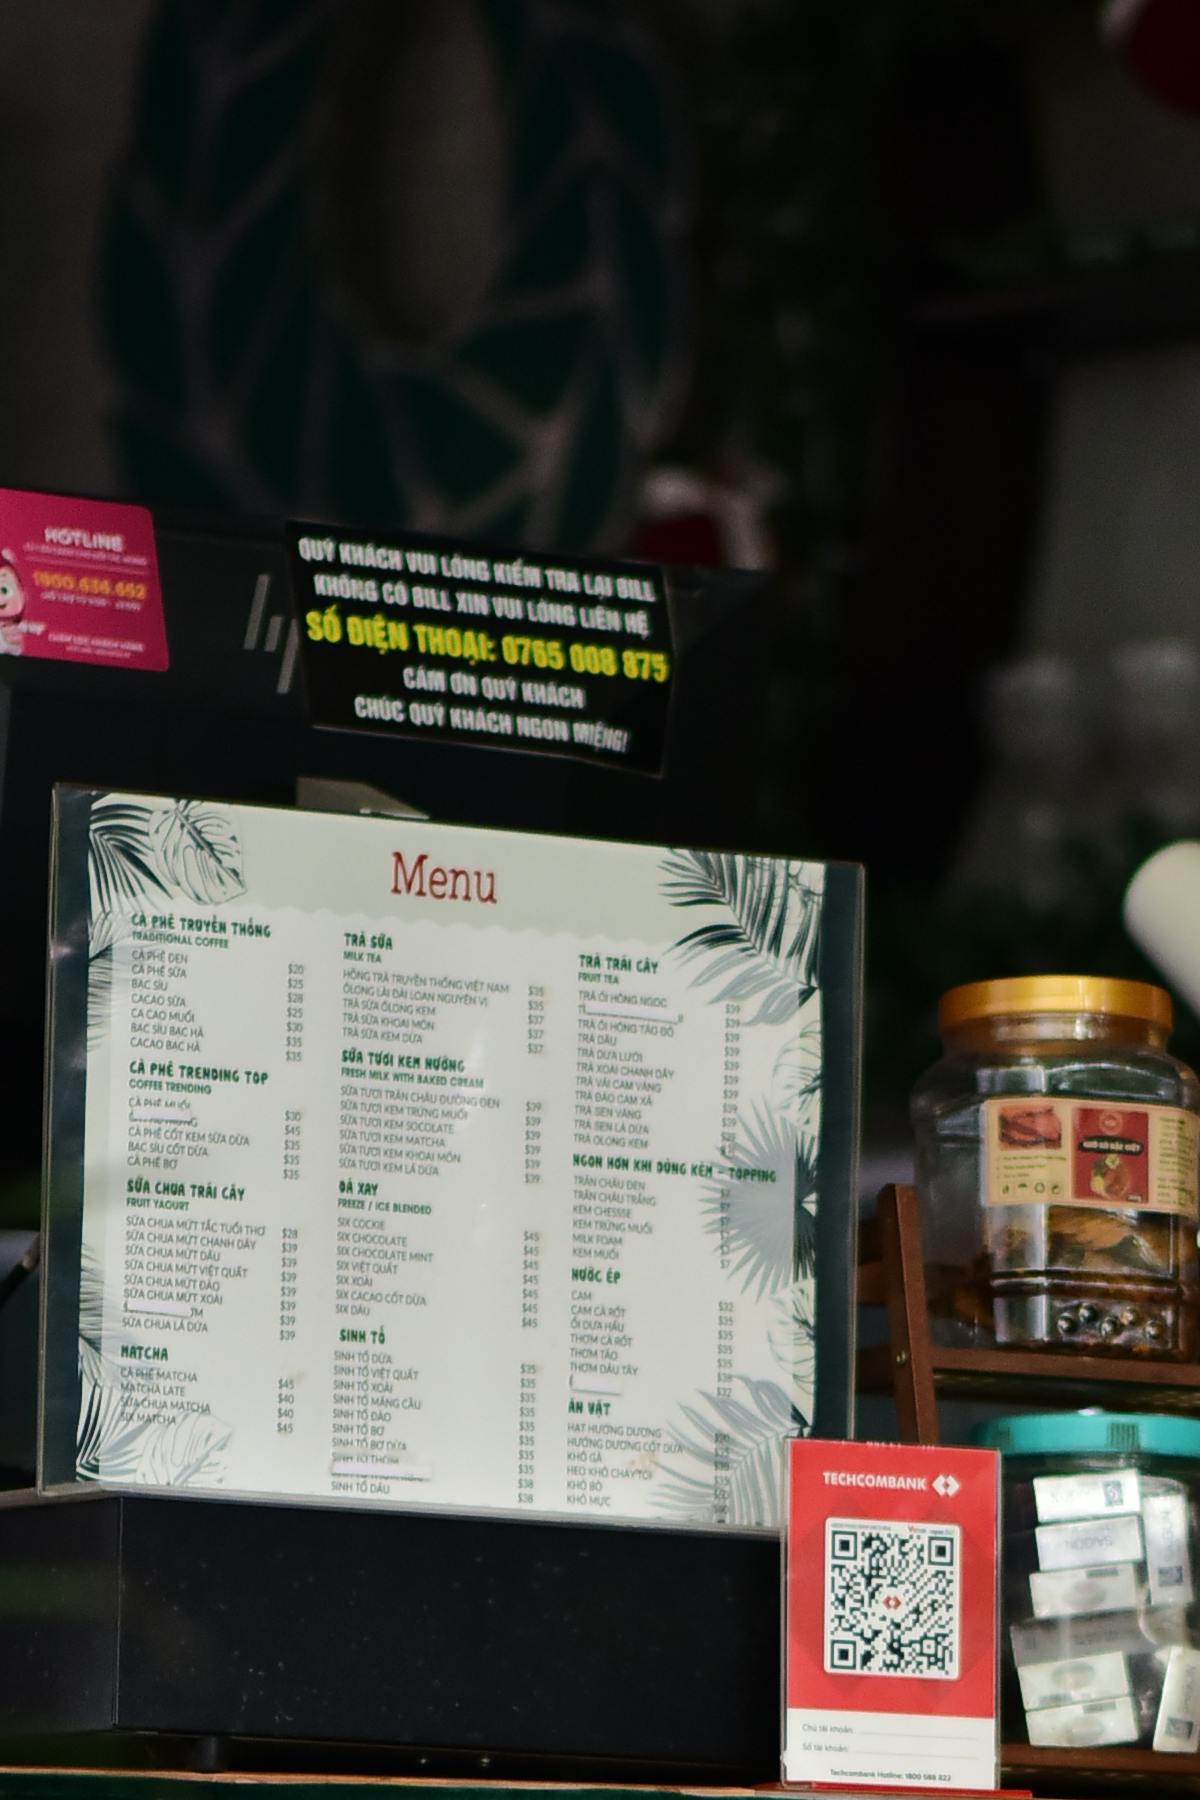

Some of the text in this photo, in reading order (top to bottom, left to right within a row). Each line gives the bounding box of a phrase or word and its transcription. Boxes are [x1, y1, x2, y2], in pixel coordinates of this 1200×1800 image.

[44, 527, 124, 552] HOTLINE
[340, 542, 402, 571] KHÁCH
[407, 552, 437, 575] VUI
[546, 569, 581, 593] TRA
[618, 578, 656, 602] BILL
[314, 574, 377, 602] KHÔNG
[413, 587, 452, 611] BILL
[456, 591, 488, 616] XIN
[493, 596, 522, 619] VUI
[306, 604, 342, 643] SỐ
[347, 614, 409, 655] ĐIỆN
[502, 635, 563, 669] 0765
[570, 644, 617, 676] 008
[623, 651, 670, 684] 875
[354, 695, 405, 722] CHÚC
[516, 716, 569, 742] NGON
[391, 851, 498, 904] Menu
[131, 912, 145, 927] CÀ
[152, 913, 175, 930] PHÊ
[132, 930, 228, 948] TRADITIONAL COFFEE
[344, 931, 393, 951] TRÀ SỮA
[343, 951, 382, 963] MILK TEA
[288, 964, 304, 975] $20
[288, 978, 303, 989] $25
[578, 972, 619, 984] FRUIT TEA
[131, 994, 165, 1005] CACAO
[398, 1055, 421, 1069] KEM
[129, 1059, 269, 1085] CÀ PHÊ TRENDING TOP
[341, 1067, 484, 1089] FRESH MILK WITH BAKED CREAM
[129, 1079, 212, 1095] COFFEE TRENDING
[285, 1110, 301, 1121] $30
[284, 1125, 301, 1136] $45
[384, 1134, 403, 1144] KEM
[405, 1135, 445, 1147] MATCHA
[573, 1154, 603, 1168] NGON
[633, 1158, 652, 1173] KHI
[728, 1167, 776, 1184] TOPPING
[155, 1179, 185, 1197] CHUA
[358, 1181, 379, 1196] XAY
[126, 1198, 151, 1208] FRUIT
[337, 1198, 365, 1210] FREEZE
[375, 1201, 390, 1212] ICE
[393, 1202, 432, 1215] BLENDED
[337, 1232, 407, 1247] SIX CHOCOLATE
[524, 1231, 540, 1242] $45
[572, 1234, 623, 1246] MILK FOAM
[281, 1243, 298, 1253] $39
[337, 1246, 434, 1263] SIX CHOCOLATE MINT
[146, 1262, 172, 1272] CHUA
[147, 1290, 173, 1301] CHUA
[571, 1291, 592, 1301] CAM
[718, 1316, 733, 1326] $35
[339, 1328, 366, 1343] SINH
[120, 1344, 169, 1361] MATCHA
[520, 1363, 536, 1374] $35
[163, 1386, 185, 1397] LATE
[278, 1393, 294, 1404] $40
[332, 1423, 353, 1434] SINH
[823, 1471, 927, 1491] TECHCOMBANK
[830, 1769, 875, 1777] Techcombank
